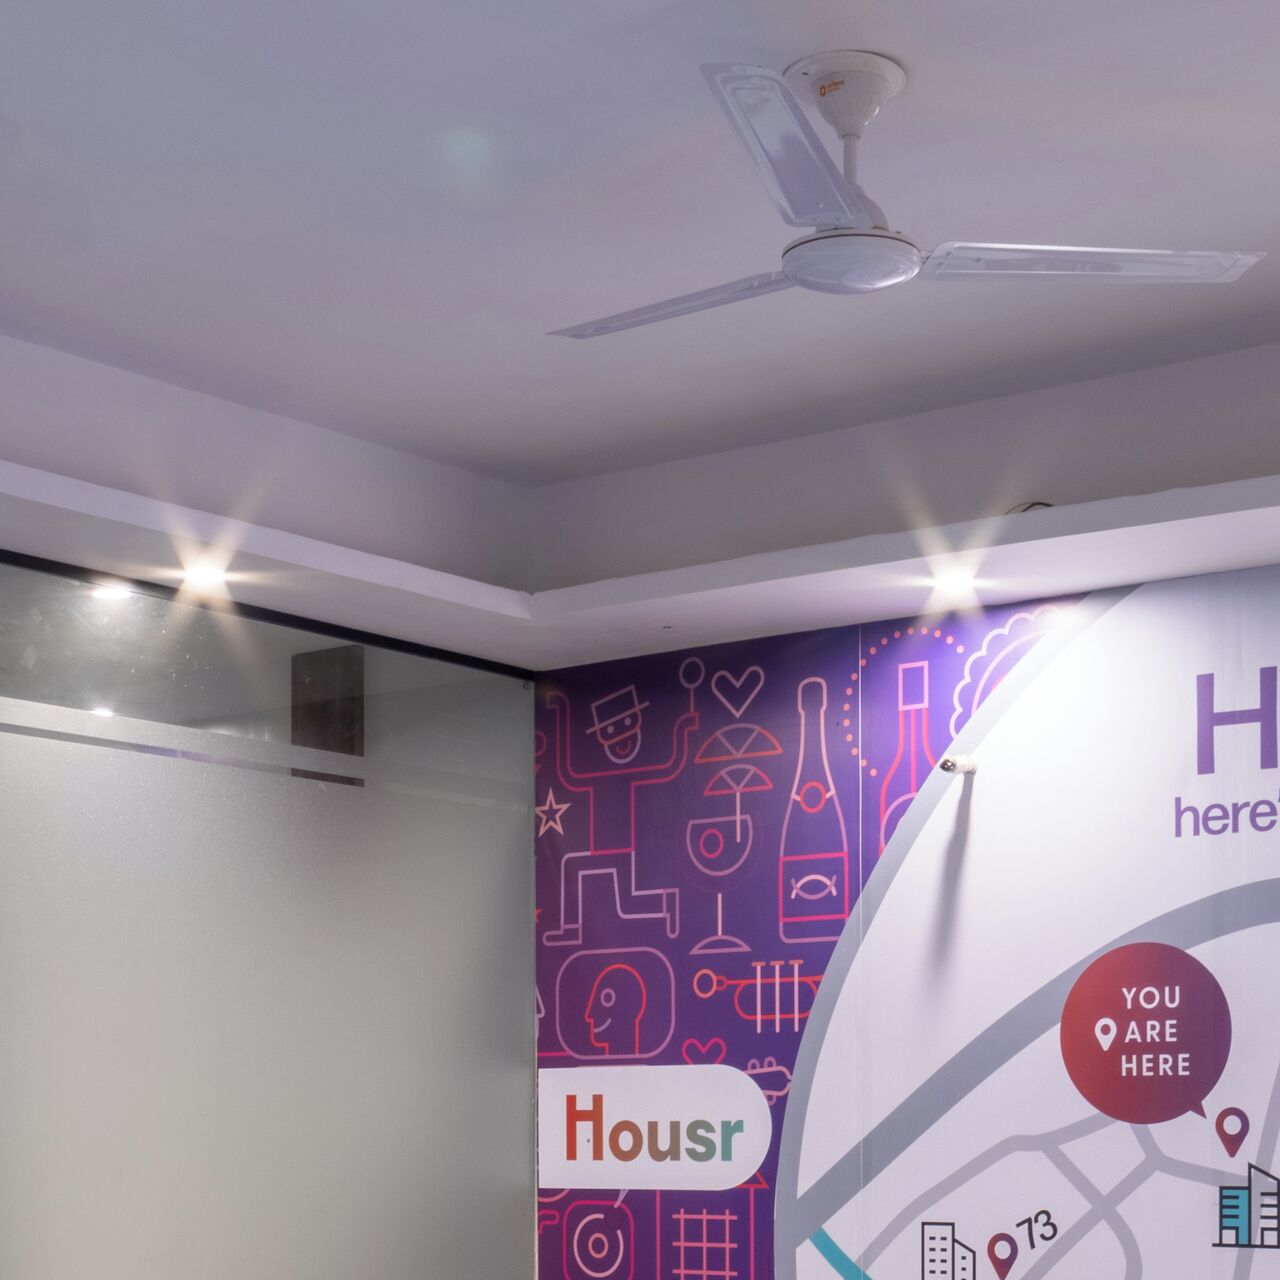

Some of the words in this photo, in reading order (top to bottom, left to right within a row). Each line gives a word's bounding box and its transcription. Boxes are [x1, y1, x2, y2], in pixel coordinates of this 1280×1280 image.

[1122, 986, 1181, 1010] YOU
[1125, 1020, 1177, 1043] ARE
[1121, 1053, 1190, 1077] HERE
[566, 1094, 743, 1161] Housr
[1016, 1210, 1058, 1249] 73
